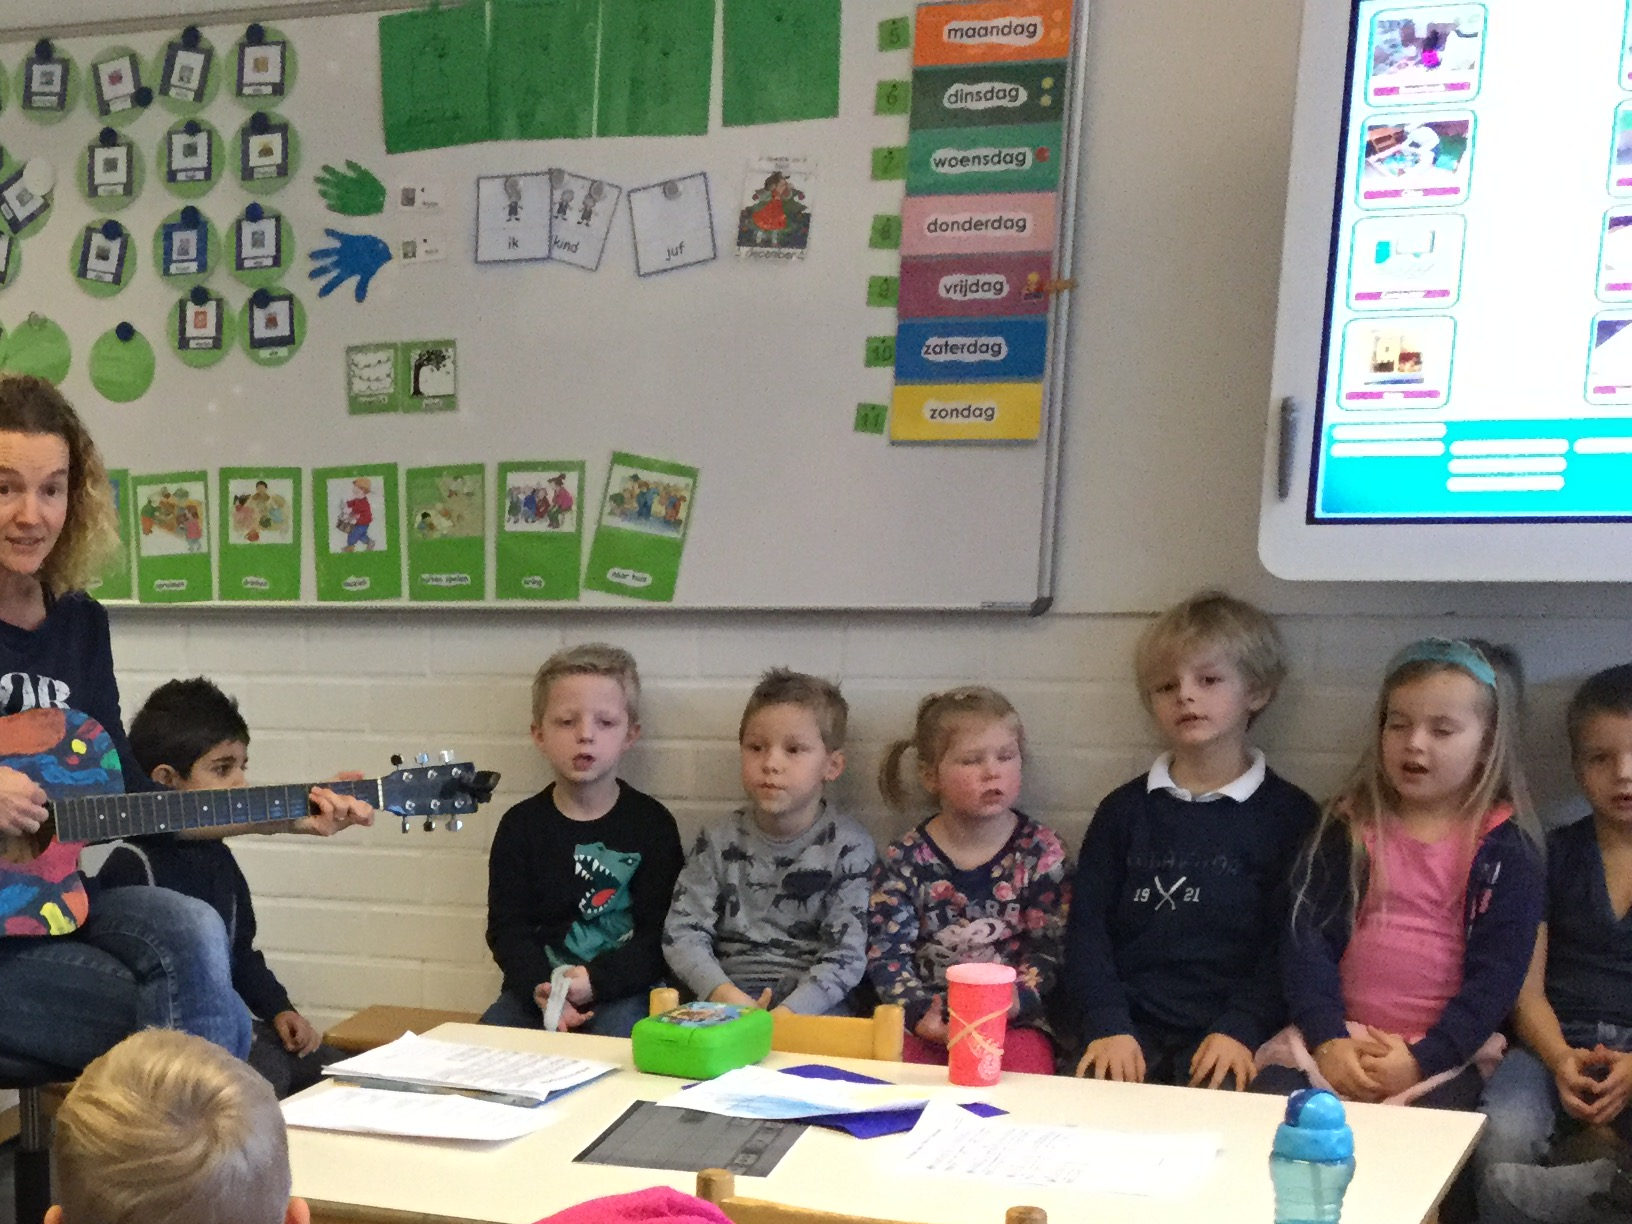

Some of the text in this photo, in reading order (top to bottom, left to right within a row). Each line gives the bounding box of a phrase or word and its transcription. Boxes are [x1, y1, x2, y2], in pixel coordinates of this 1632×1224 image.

[947, 20, 1037, 39] maandag
[947, 86, 1019, 105] dinsdag
[933, 150, 1027, 169] woensdag
[926, 215, 1027, 234] donderdag
[508, 236, 519, 249] ik
[665, 241, 685, 261] juf
[944, 278, 1005, 296] vrijdag
[923, 340, 1003, 358] zaterdag
[929, 404, 995, 422] zondag
[1133, 887, 1151, 903] 19
[1183, 886, 1201, 903] 21
